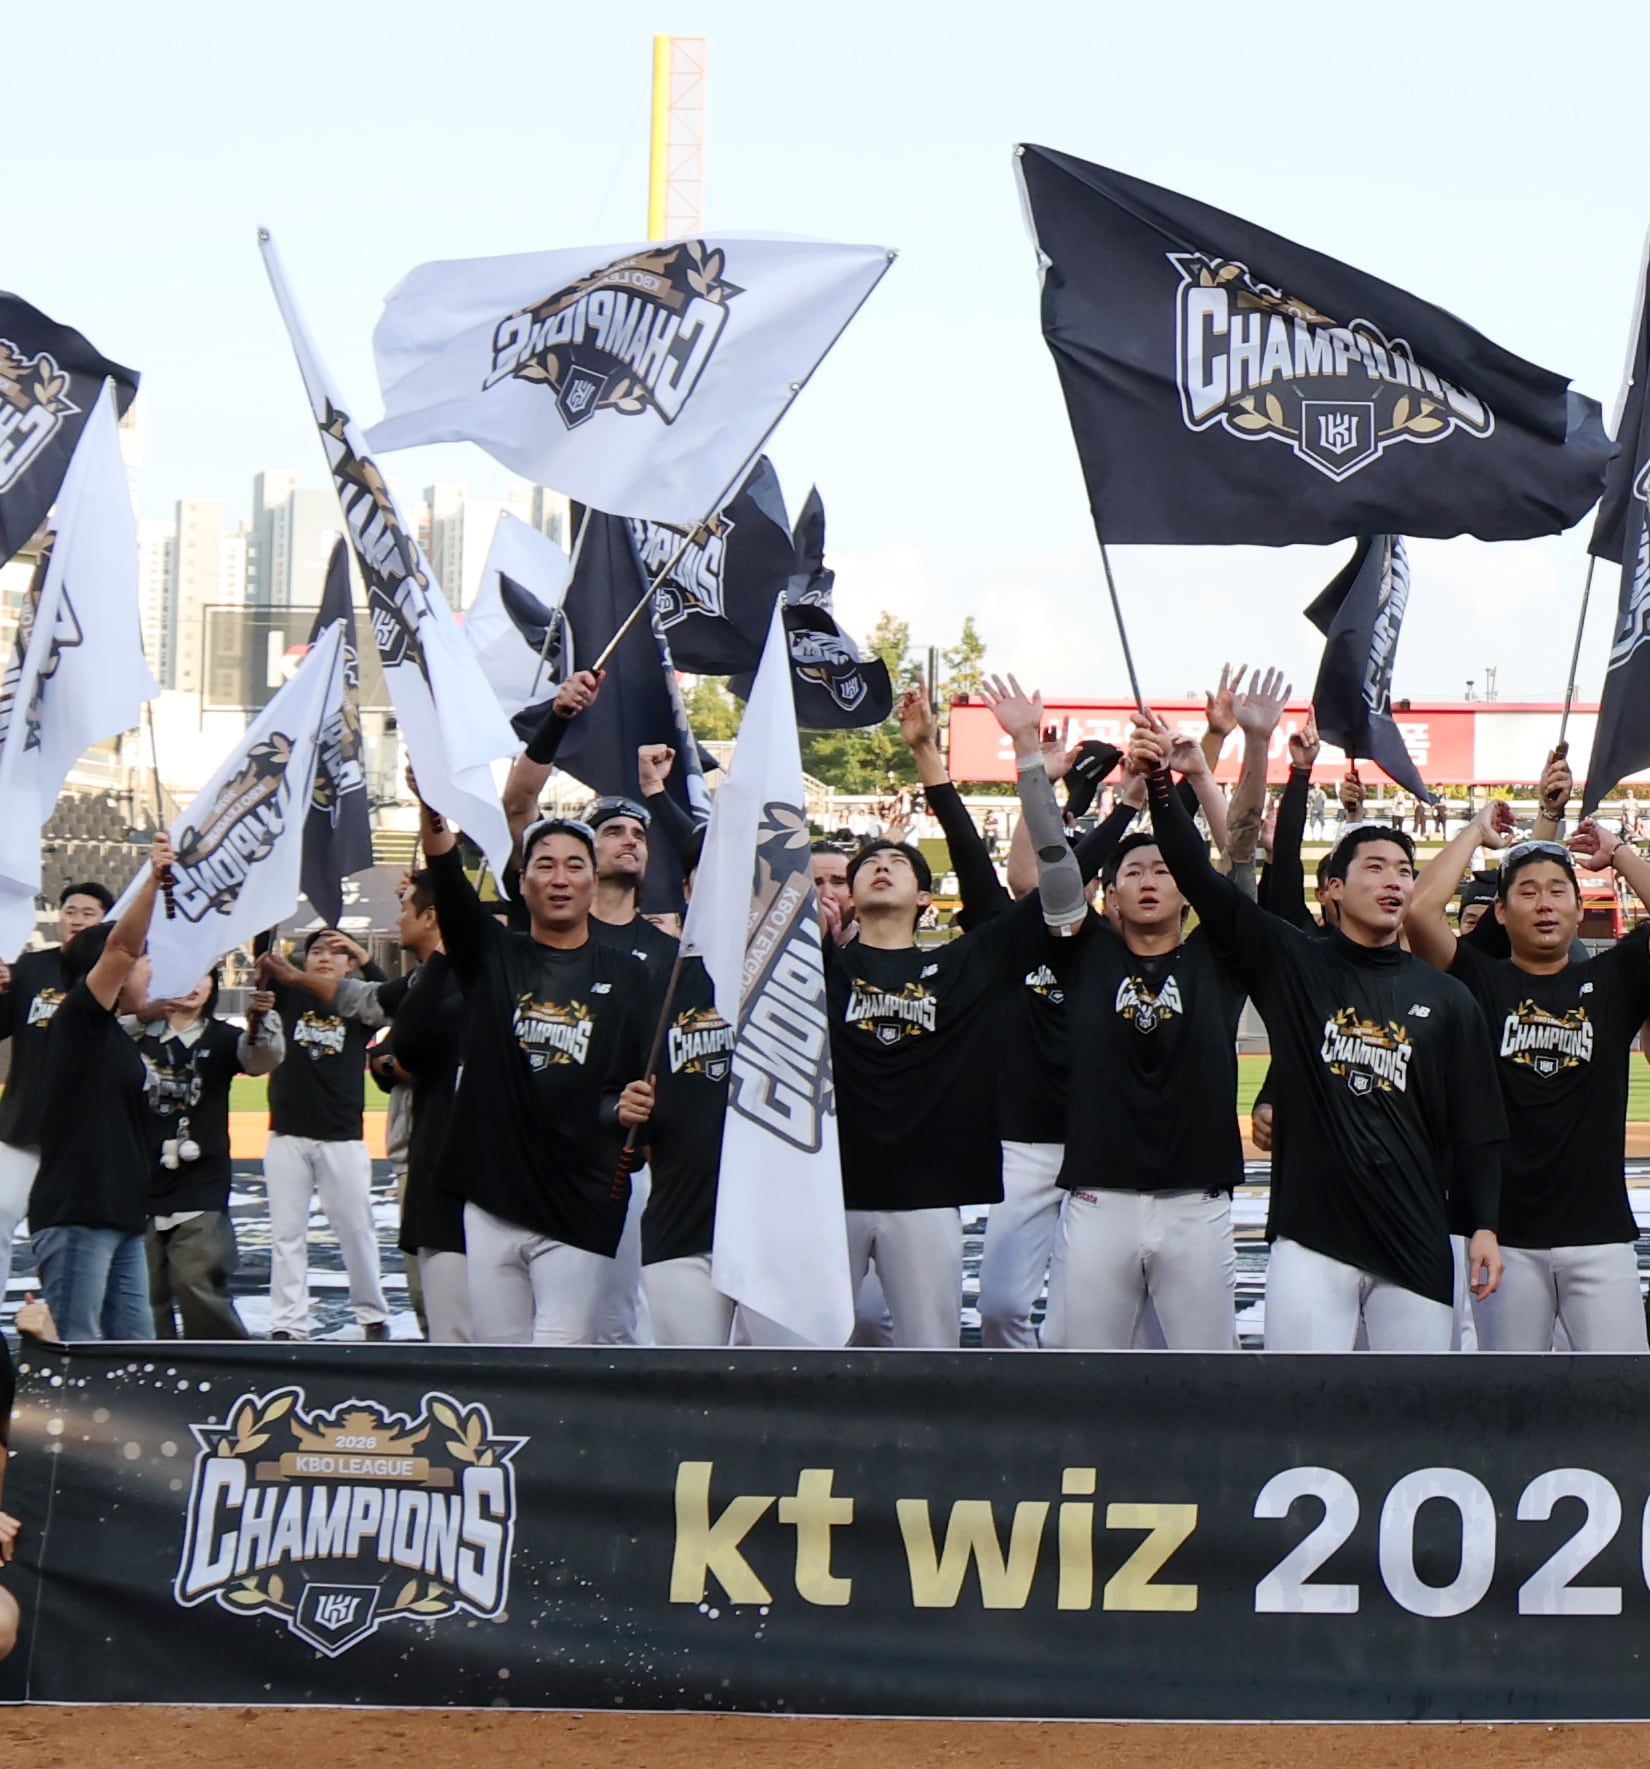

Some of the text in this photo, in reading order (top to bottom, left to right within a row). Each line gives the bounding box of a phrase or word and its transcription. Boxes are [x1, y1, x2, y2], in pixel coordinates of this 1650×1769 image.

[845, 989, 938, 1032] CHAMPIONS
[1500, 1016, 1593, 1063] CHAMPIONS
[335, 1435, 378, 1450] 2026
[295, 1456, 414, 1476] KBO LEAGUE
[185, 1457, 505, 1610] CHAMPIONS
[670, 1461, 854, 1606] kt
[896, 1467, 1198, 1612] wiz
